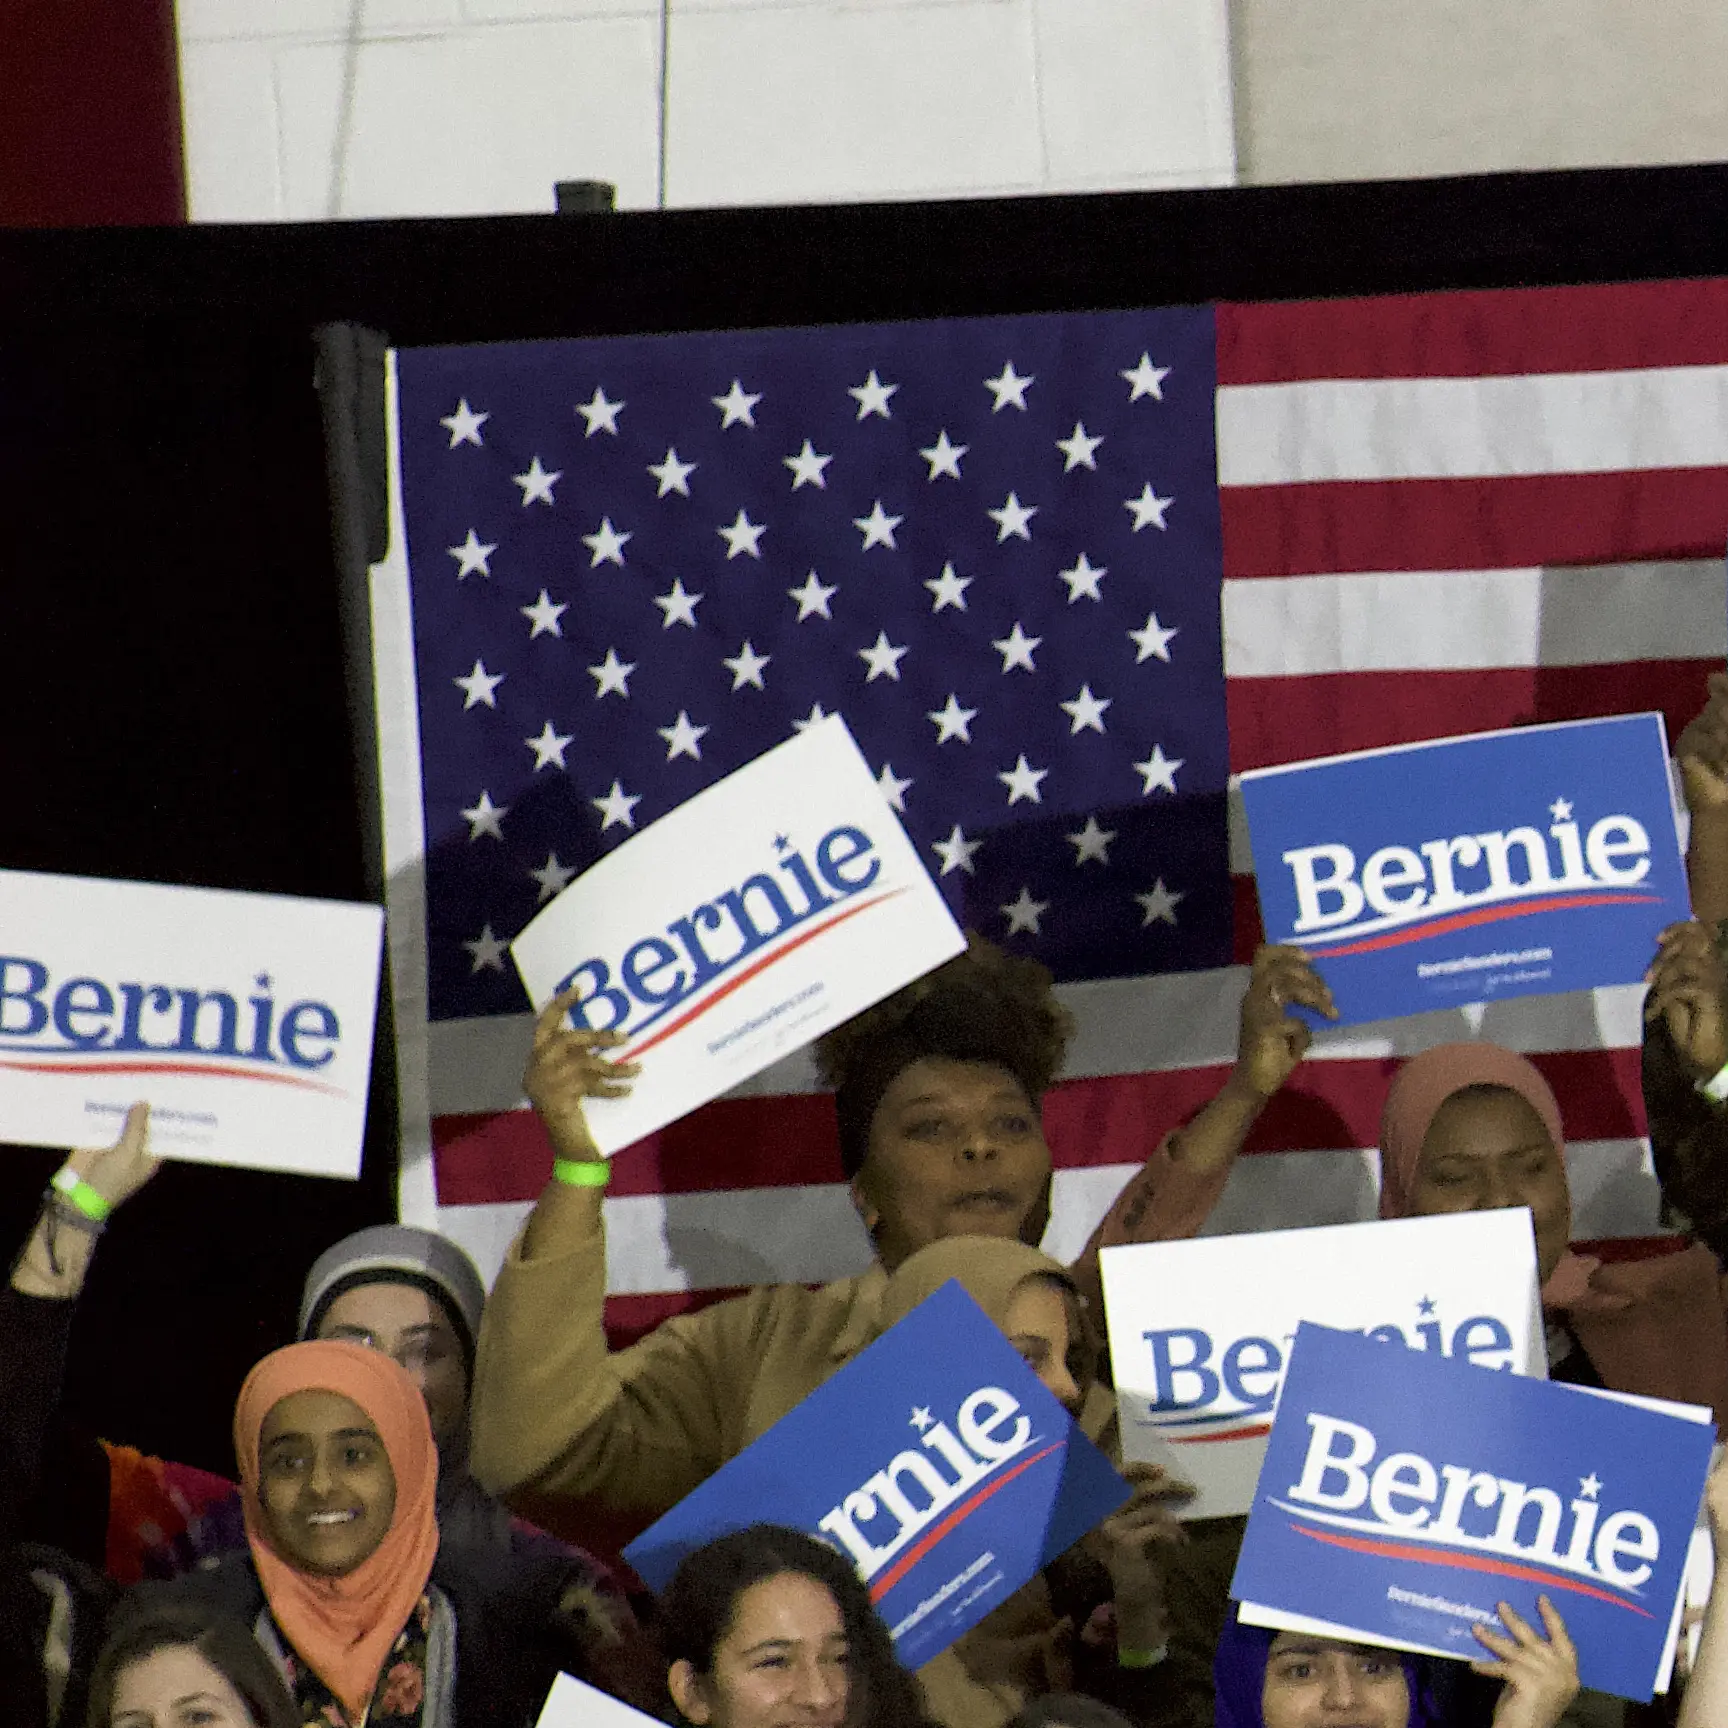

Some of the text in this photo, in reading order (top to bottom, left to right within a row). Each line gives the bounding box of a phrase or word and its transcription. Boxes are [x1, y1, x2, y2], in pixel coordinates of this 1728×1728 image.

[555, 822, 882, 1034] Bernie
[1282, 797, 1652, 934] Bernie
[0, 955, 341, 1069] Bernie
[1142, 1296, 1513, 1412] Beie
[820, 1387, 1032, 1582] rnie
[1287, 1413, 1661, 1589] Bernie
